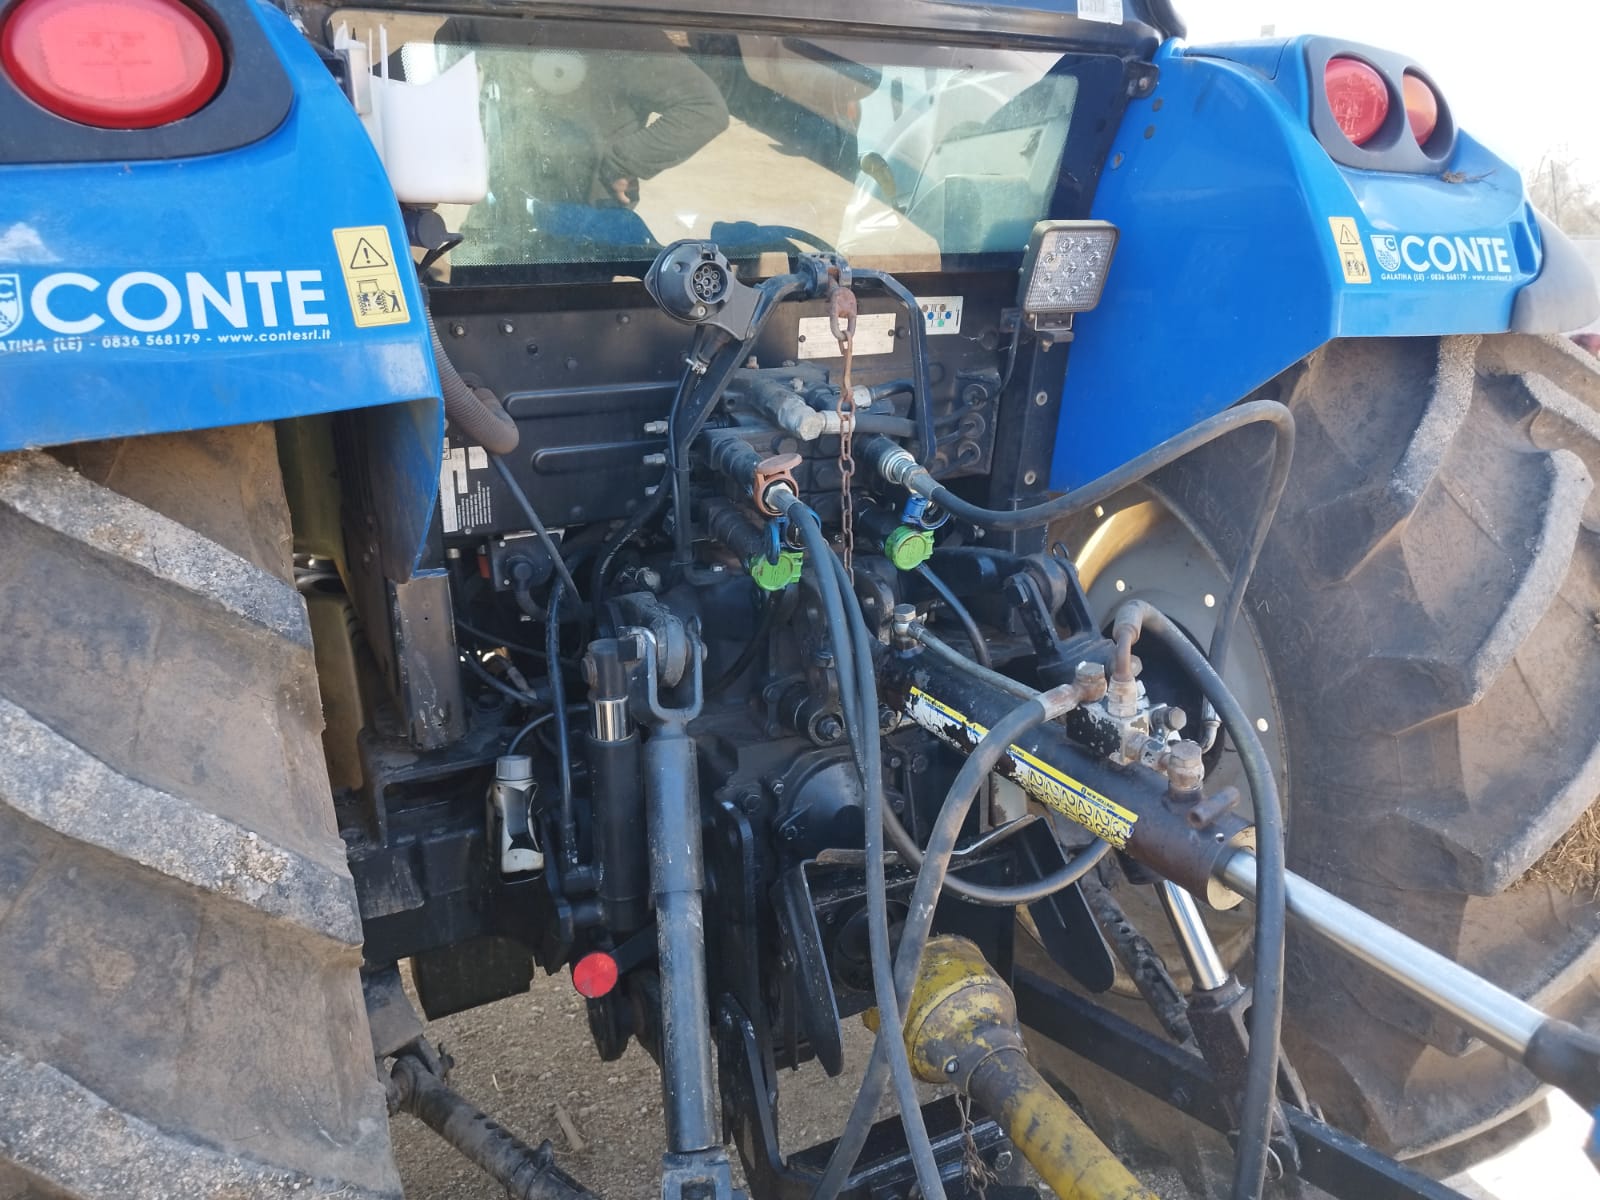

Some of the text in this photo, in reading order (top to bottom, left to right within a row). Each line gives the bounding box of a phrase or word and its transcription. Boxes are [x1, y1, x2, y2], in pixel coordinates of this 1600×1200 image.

[1401, 235, 1512, 273] CONTE
[30, 270, 329, 335] CONTE
[53, 336, 82, 353] (LE)
[101, 335, 140, 349] 0836
[145, 333, 201, 346] 568179
[218, 328, 331, 343] www.contesrl.it
